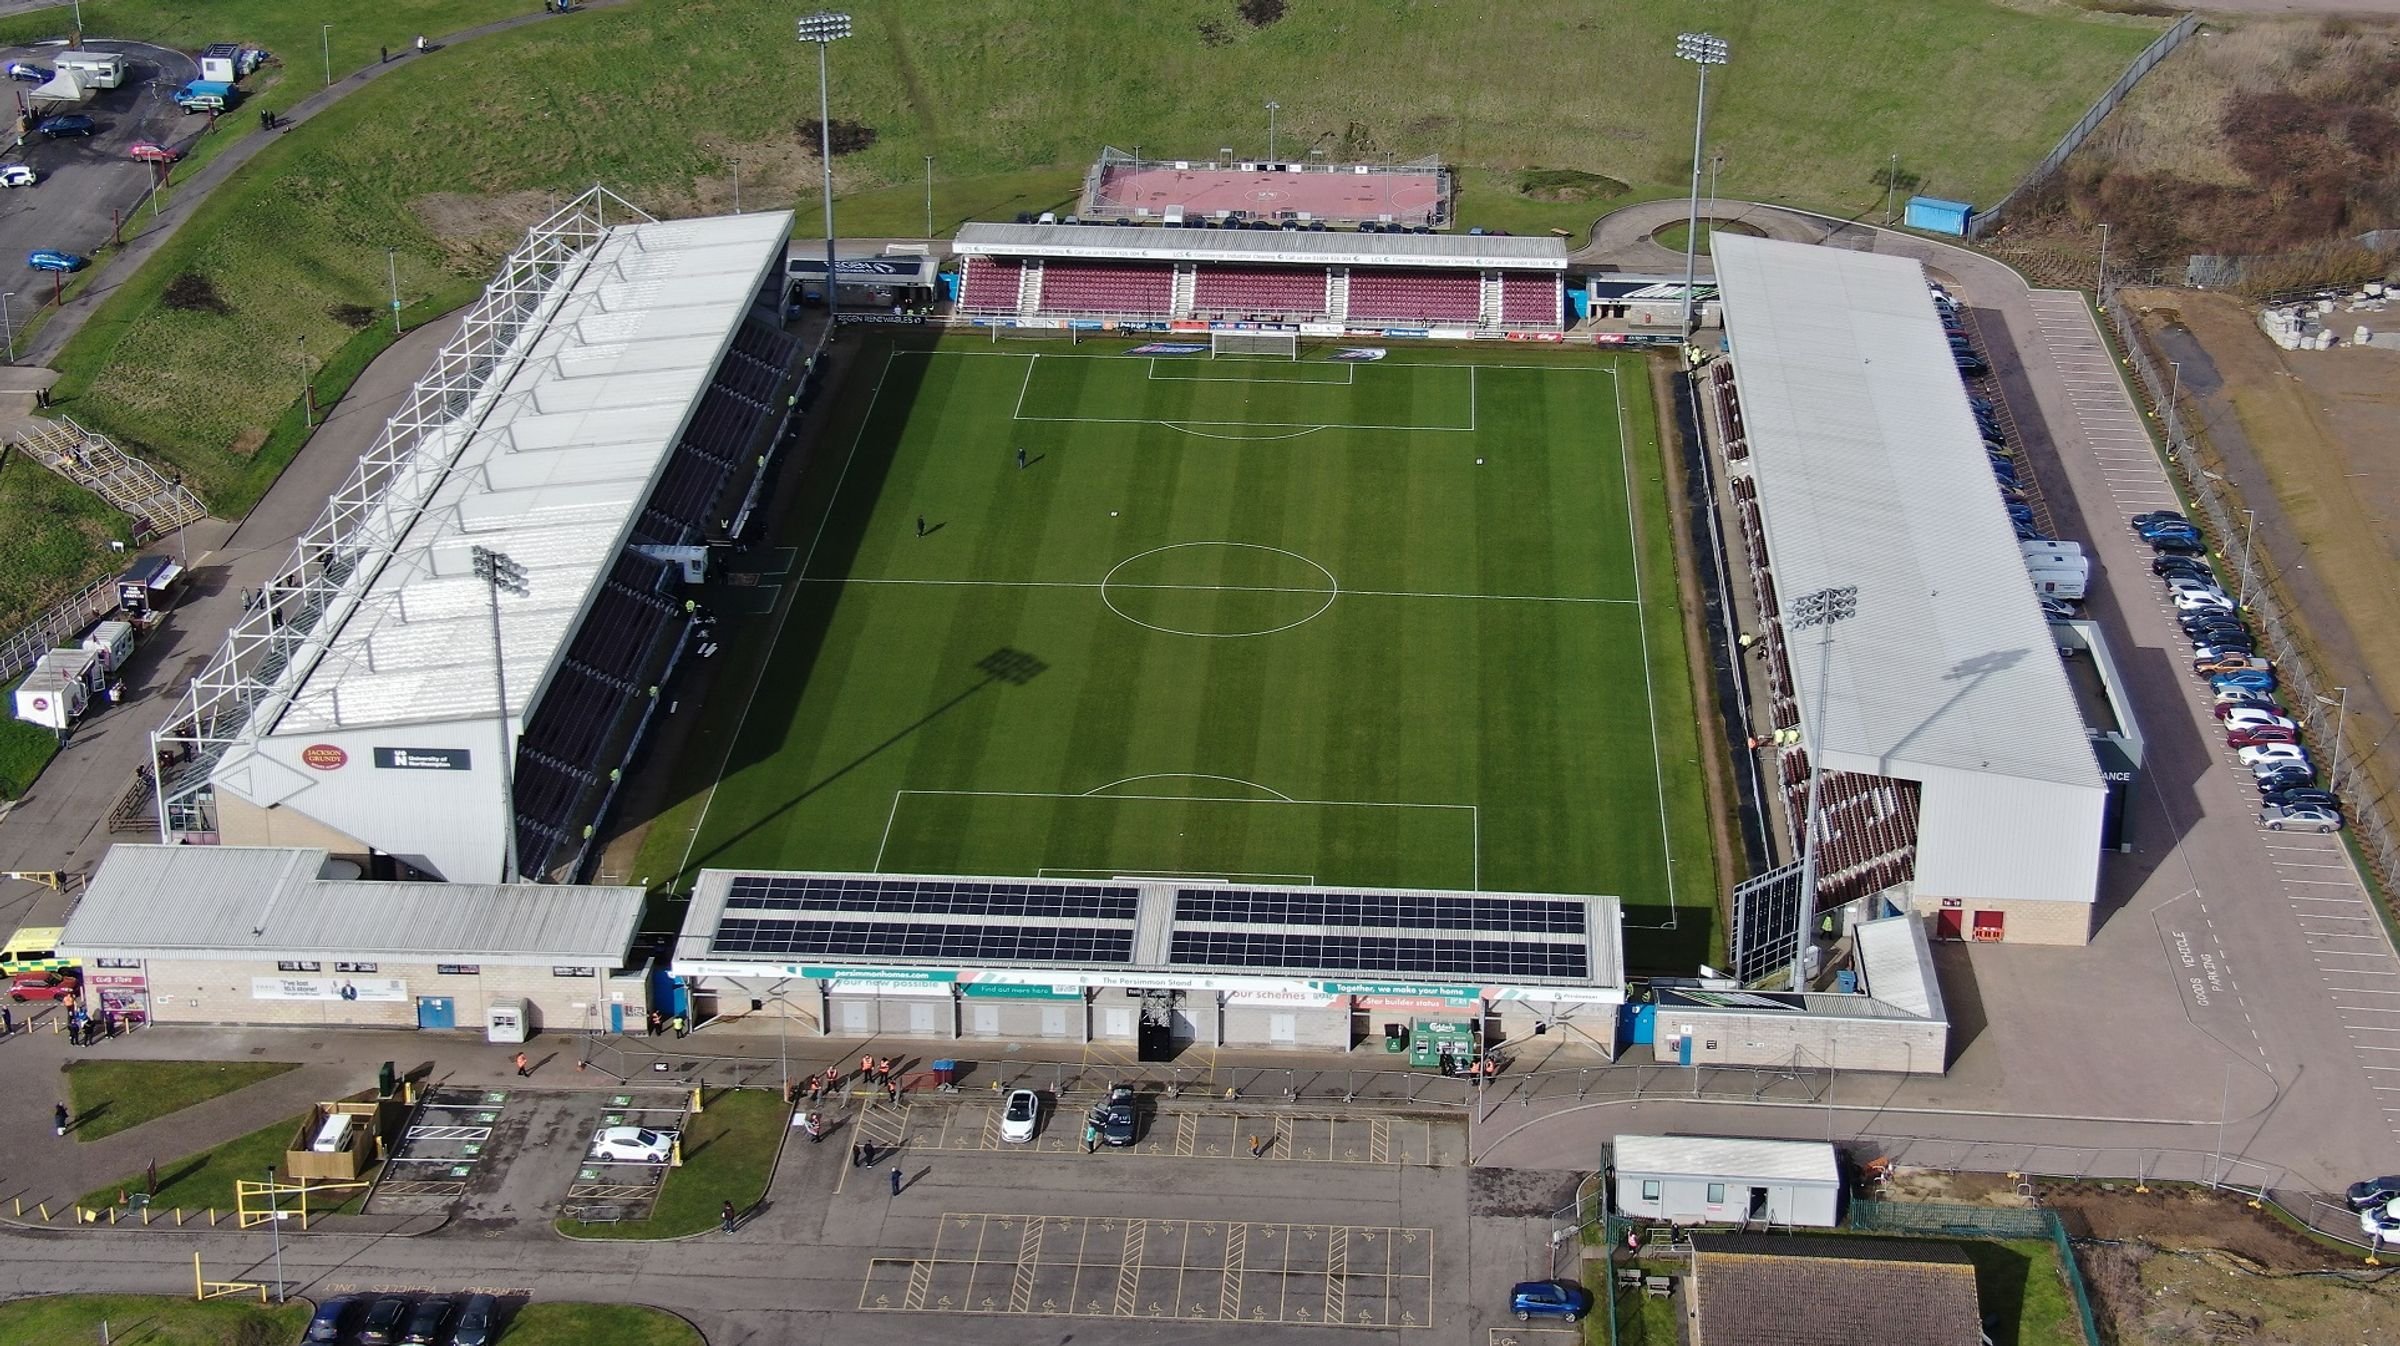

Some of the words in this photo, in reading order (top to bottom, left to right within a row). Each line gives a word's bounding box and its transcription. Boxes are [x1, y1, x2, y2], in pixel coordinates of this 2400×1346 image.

[308, 749, 341, 757] JACKSON
[309, 755, 342, 763] GRUNDY
[408, 756, 438, 764] University
[408, 761, 451, 770] Northampton
[2103, 772, 2131, 781] ANCE
[2172, 931, 2196, 968] VEHICLE
[834, 970, 929, 980] persimmonhomes.com
[2200, 953, 2223, 992] PARKING
[1119, 977, 1166, 985] Persimmon
[1168, 978, 1192, 986] Stand
[981, 985, 996, 993] Find
[1336, 984, 1375, 994] Together,
[1393, 986, 1416, 994] make
[1418, 987, 1438, 997] your
[1439, 987, 1464, 996] home
[2190, 977, 2209, 1006] GOODS
[1385, 997, 1413, 1006] builder
[1416, 999, 1440, 1007] status
[325, 1283, 357, 1293] ONLY
